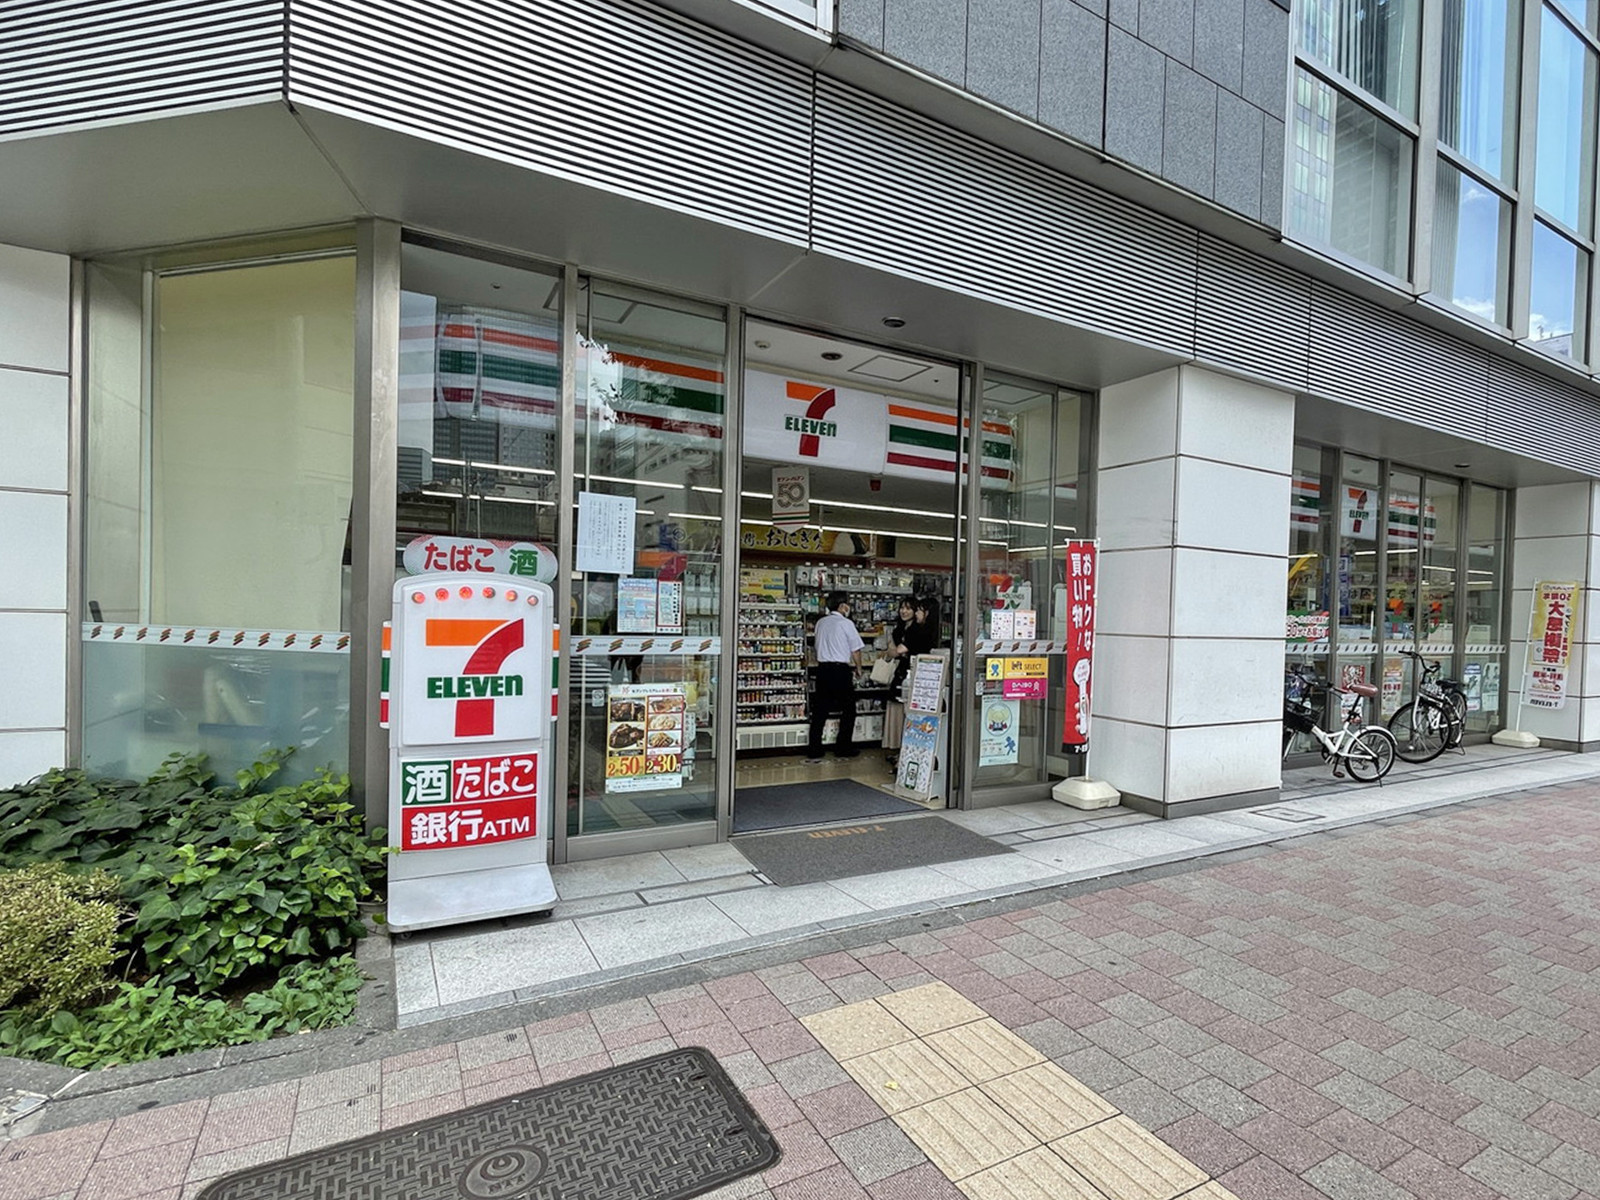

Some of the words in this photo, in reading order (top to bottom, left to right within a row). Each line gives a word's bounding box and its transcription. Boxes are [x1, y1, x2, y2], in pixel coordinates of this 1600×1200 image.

[786, 381, 836, 457] 7
[424, 542, 495, 572] たばこ
[509, 548, 538, 576] 酒
[1083, 553, 1092, 651] おトクな
[426, 618, 524, 737] 7
[427, 675, 523, 699] ELEVEn
[406, 764, 449, 804] 酒
[455, 758, 535, 800] たばこ
[608, 763, 616, 777] 2
[620, 756, 640, 775] 50
[646, 761, 654, 774] 2
[657, 754, 677, 772] 30
